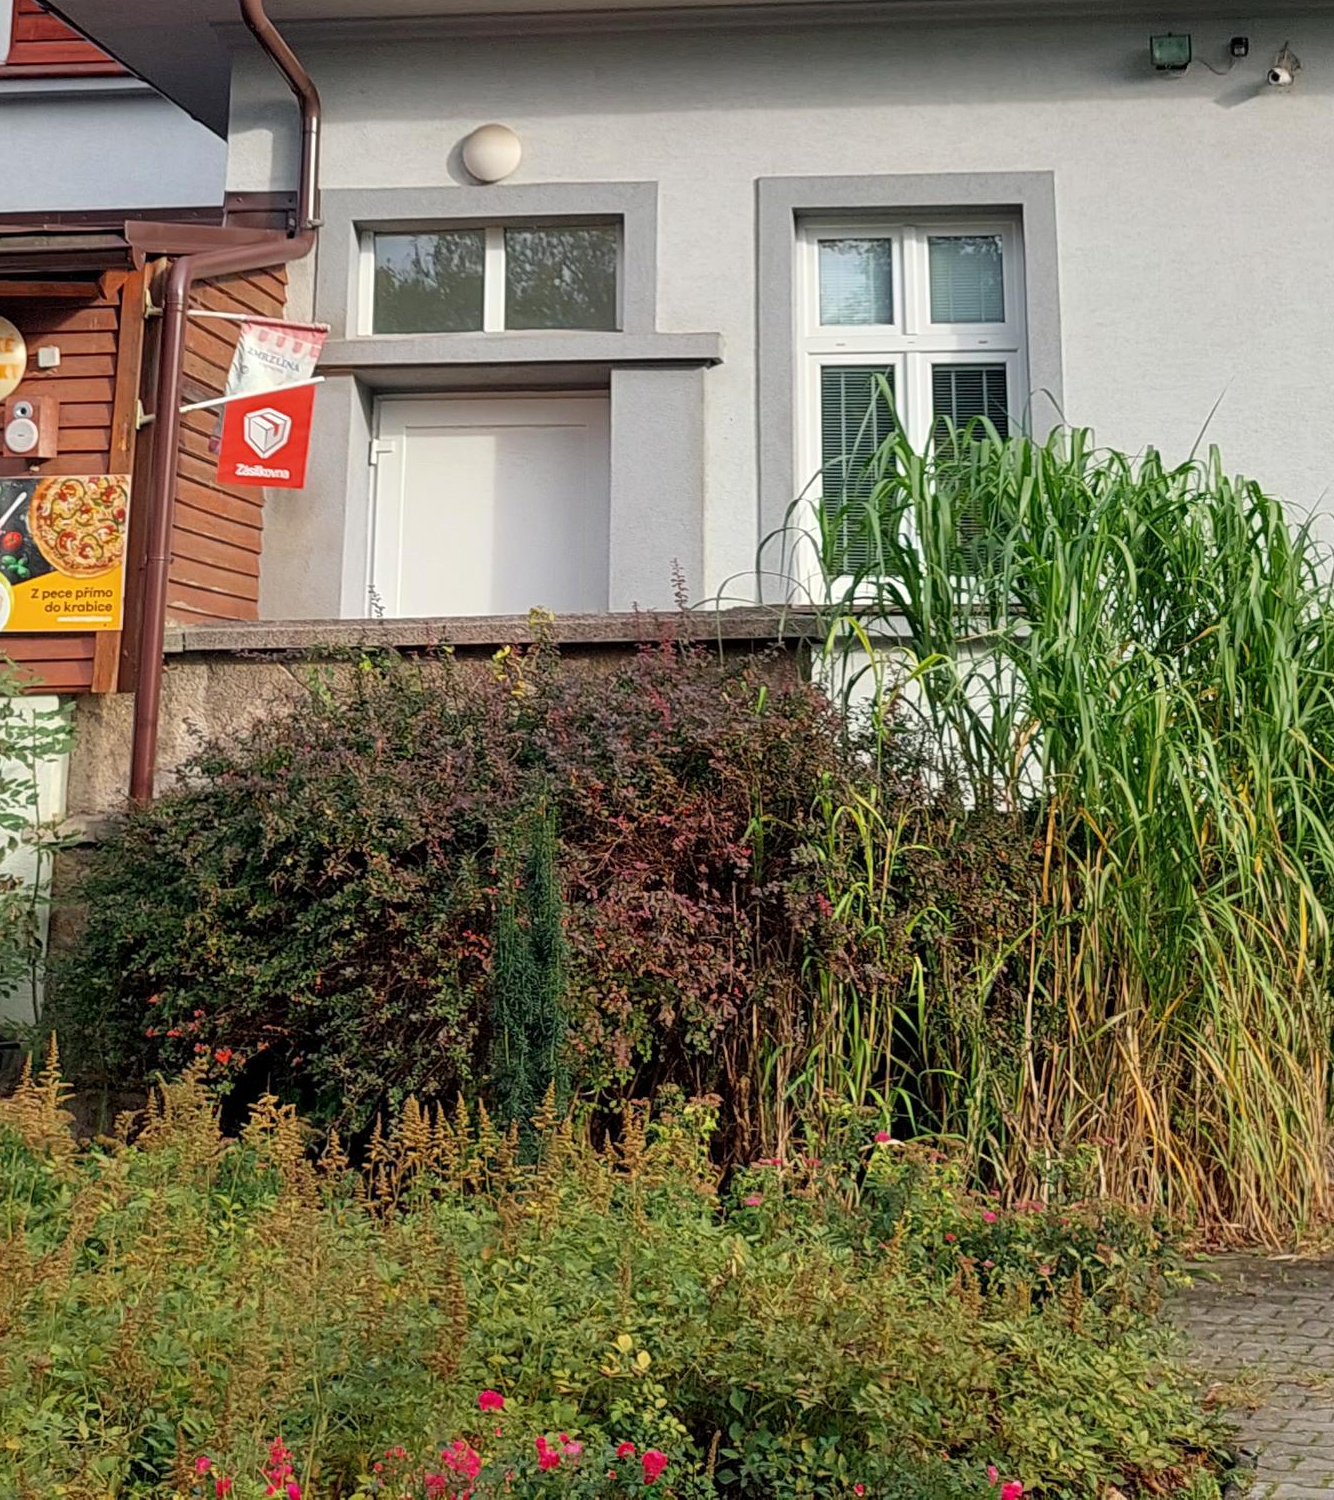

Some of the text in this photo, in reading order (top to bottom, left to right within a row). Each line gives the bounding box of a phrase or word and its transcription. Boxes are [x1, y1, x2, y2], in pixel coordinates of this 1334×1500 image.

[30, 586, 113, 601] Z pece přímo
[44, 600, 113, 613] do krabice
